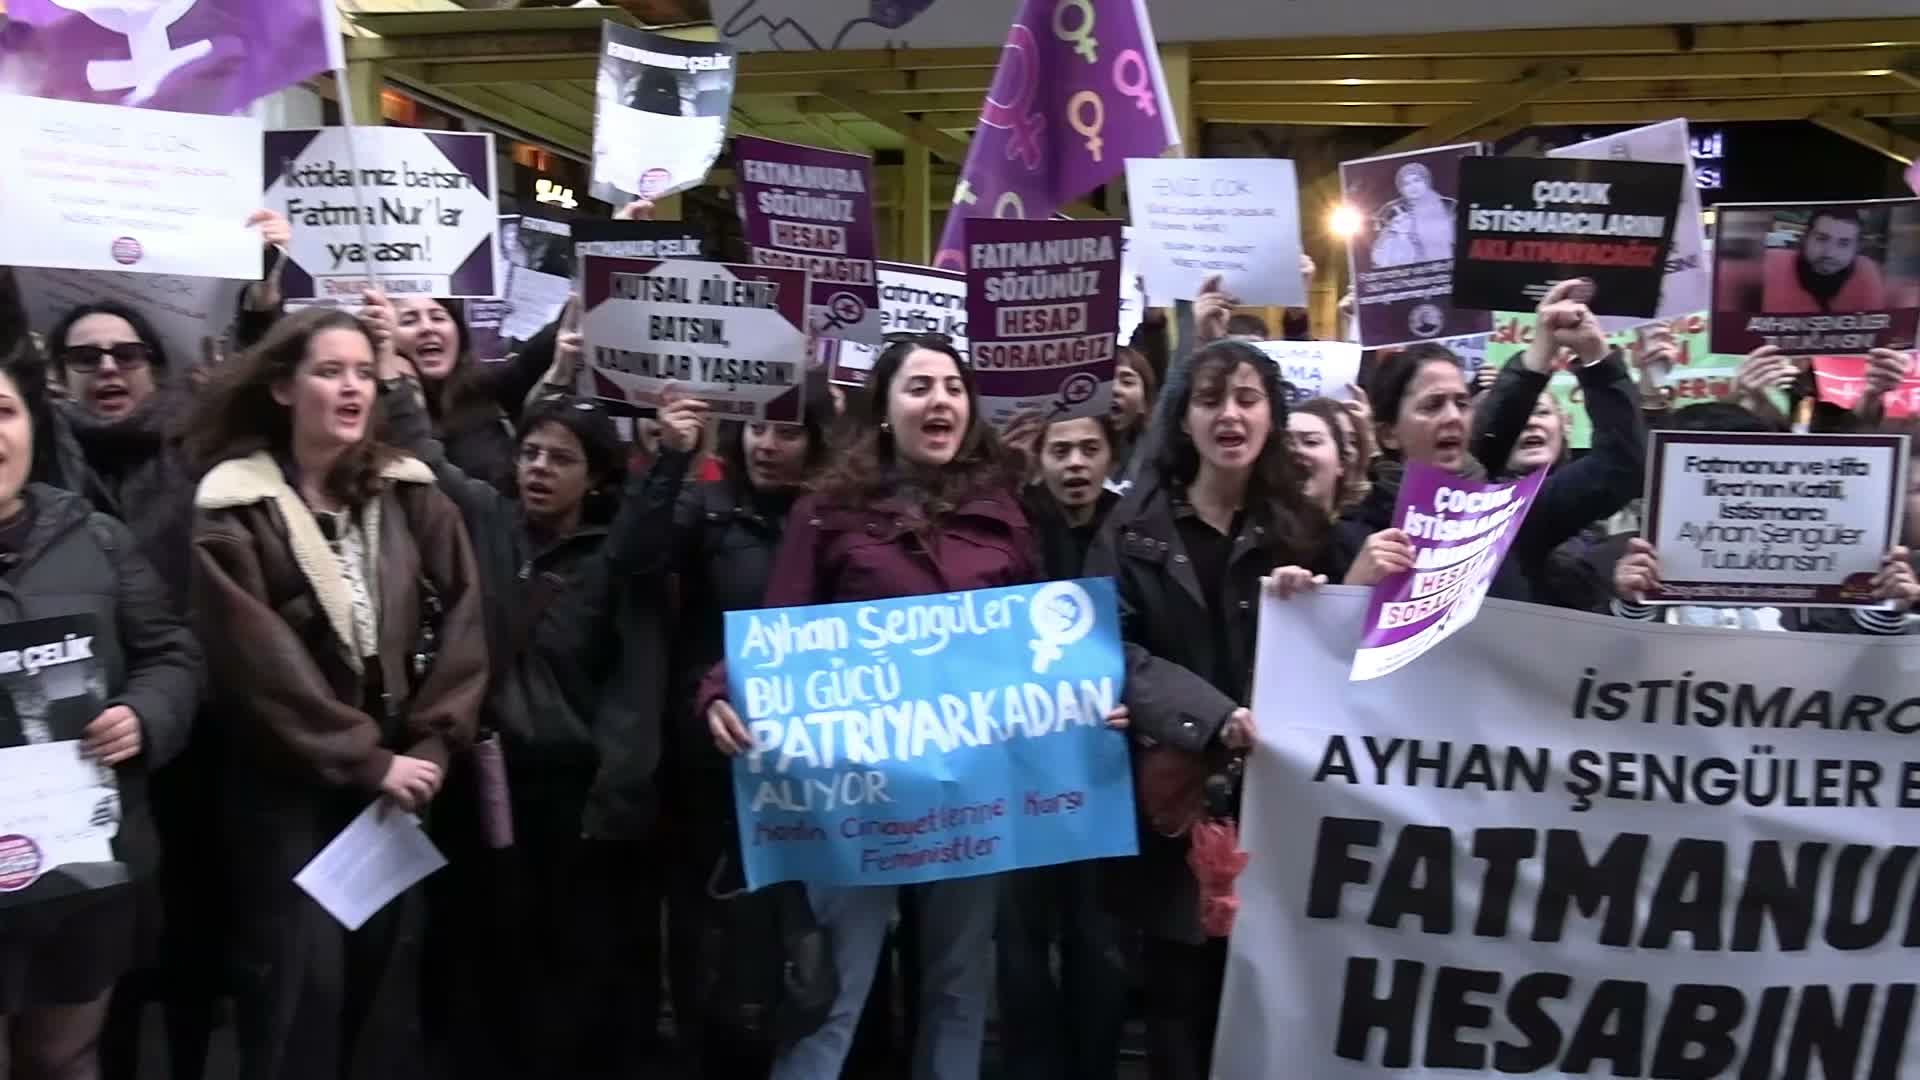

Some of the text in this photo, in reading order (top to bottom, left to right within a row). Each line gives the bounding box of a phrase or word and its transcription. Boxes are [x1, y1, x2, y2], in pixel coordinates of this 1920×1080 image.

[1533, 181, 1612, 209] ÇOCUK
[776, 225, 839, 249] HESAP
[970, 236, 1115, 269] FATMANURA
[984, 267, 1100, 302] SÖZÜMÜZ
[1004, 306, 1080, 334] HESAP
[976, 335, 1108, 368] SORACAĞIZ
[1679, 522, 1755, 547] Ayhan
[740, 592, 1027, 670] Ayhan Şengüler
[24, 633, 95, 676] ÇELİK
[745, 675, 794, 718] BU
[1572, 667, 1920, 735] İSTİSMARC
[746, 676, 1113, 773] PATRİYARKADAN
[751, 771, 892, 813] ALIYOR
[1314, 734, 1550, 794] AYHAN
[1564, 744, 1882, 812] ŞENGÜLER
[1306, 816, 1920, 953] FATMANU
[1335, 956, 1918, 1080] HESABINI
